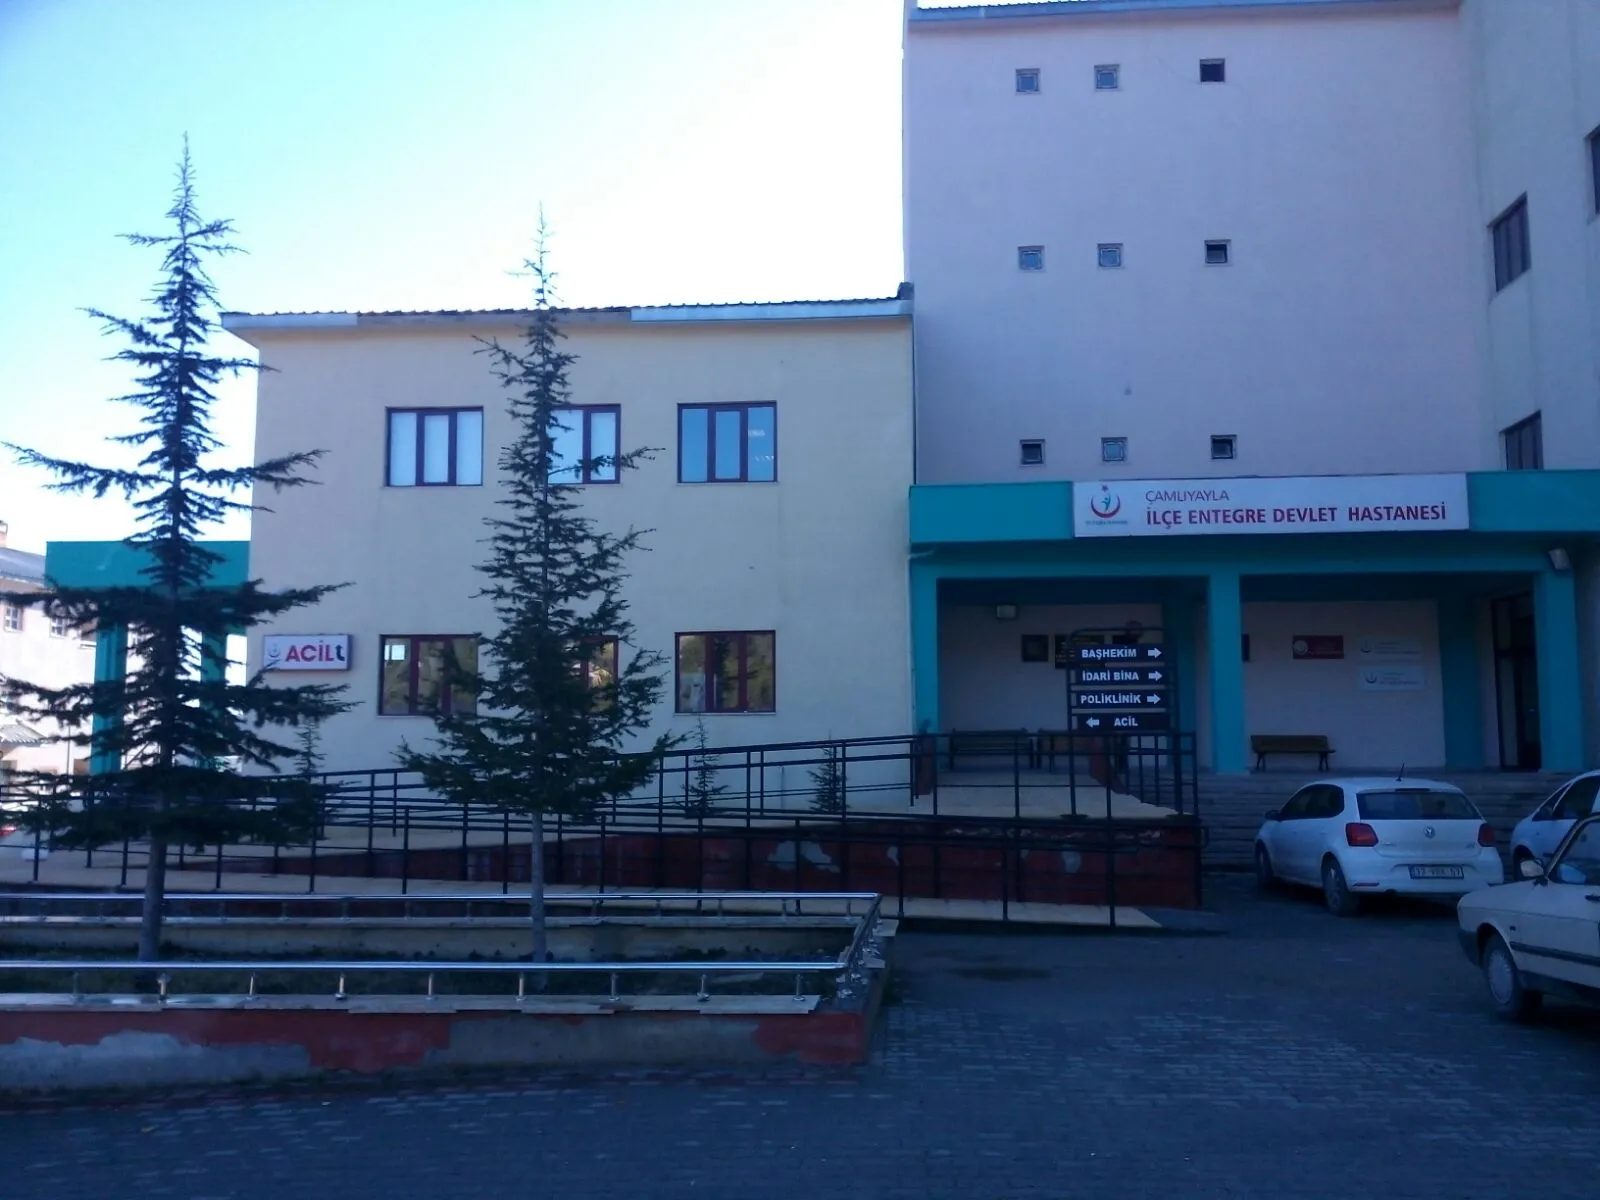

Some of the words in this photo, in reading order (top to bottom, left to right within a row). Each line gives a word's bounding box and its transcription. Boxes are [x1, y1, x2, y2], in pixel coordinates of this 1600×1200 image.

[1145, 490, 1230, 505] ÇAMLIYAYLA
[1146, 507, 1182, 529] İLÇE
[1188, 509, 1267, 524] ENTEGRE
[1273, 507, 1338, 523] DEVLET
[1348, 501, 1446, 522] HASTANESİ
[1081, 646, 1137, 660] BAŞHEKİM
[1114, 715, 1139, 727] ACİL
